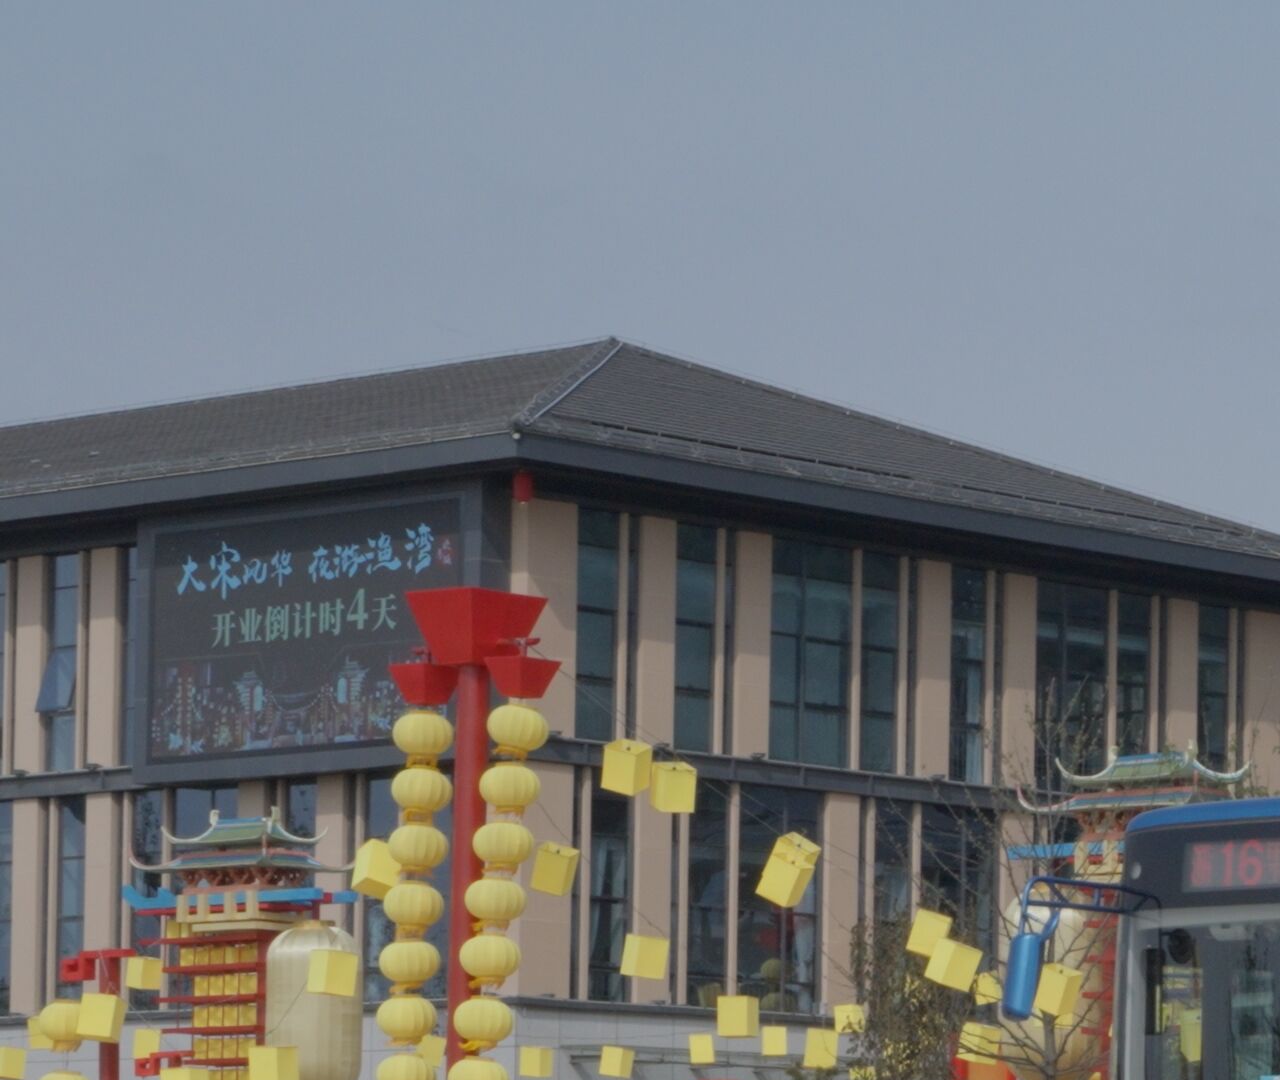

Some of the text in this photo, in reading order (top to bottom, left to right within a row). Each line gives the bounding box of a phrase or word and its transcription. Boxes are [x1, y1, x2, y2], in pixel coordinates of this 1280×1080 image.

[177, 541, 293, 599] 大宋风华
[308, 523, 434, 583] 夜游渔湾
[211, 588, 398, 648] 开业倒计时4天
